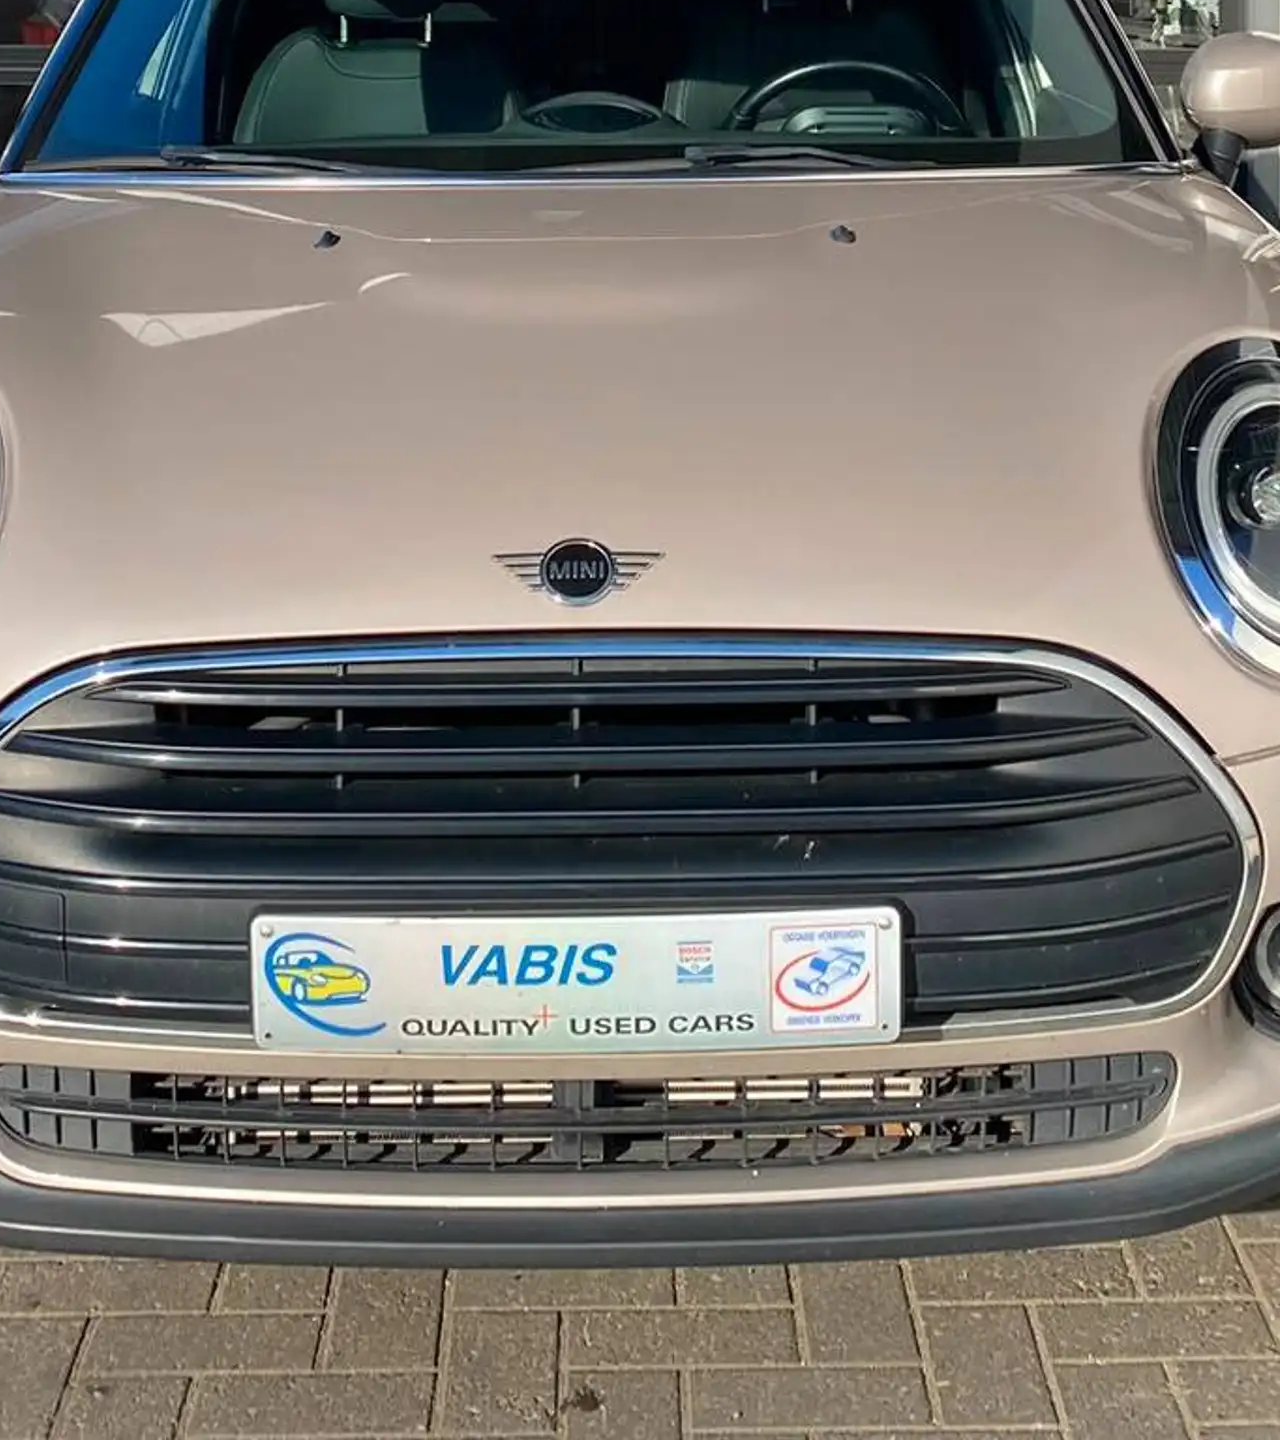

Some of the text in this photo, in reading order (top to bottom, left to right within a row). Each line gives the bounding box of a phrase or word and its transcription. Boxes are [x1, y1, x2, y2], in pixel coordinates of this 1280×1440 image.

[548, 559, 605, 581] MINI
[440, 943, 618, 986] VABIS
[401, 1013, 755, 1037] QUALITY USED CARS
